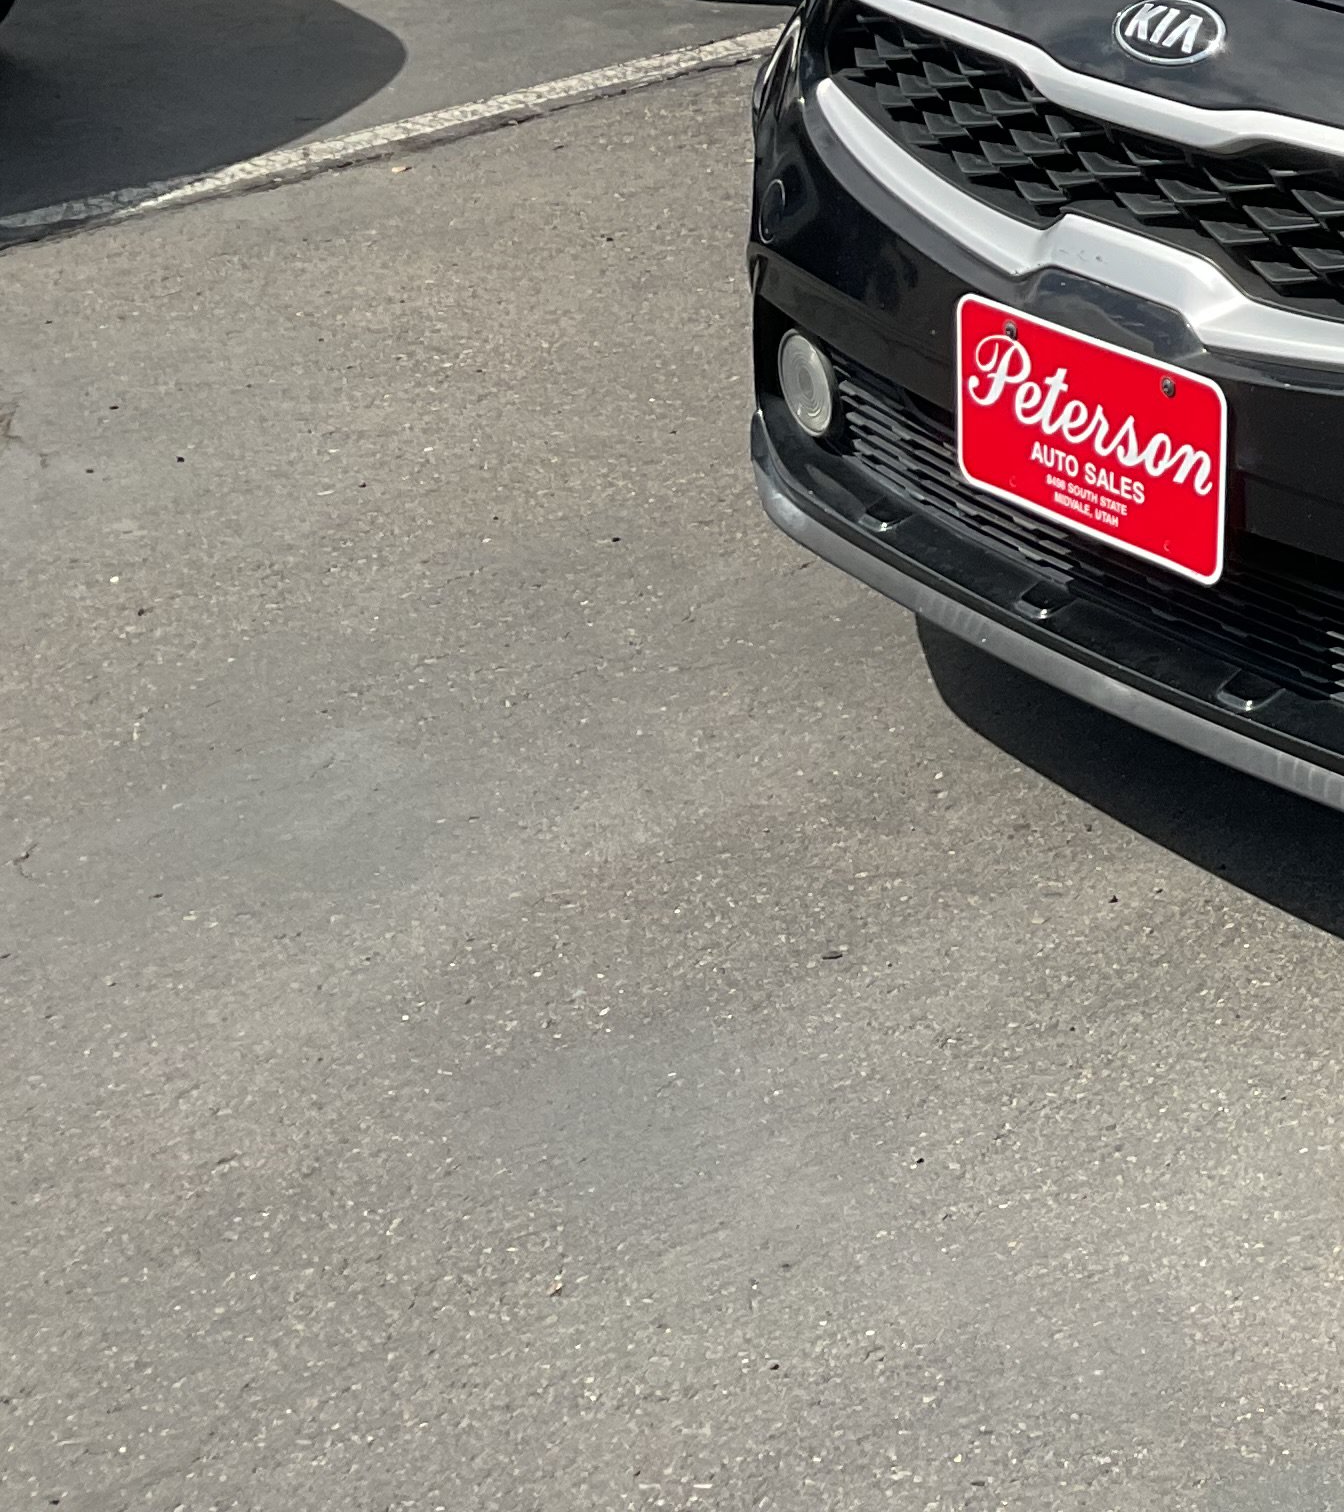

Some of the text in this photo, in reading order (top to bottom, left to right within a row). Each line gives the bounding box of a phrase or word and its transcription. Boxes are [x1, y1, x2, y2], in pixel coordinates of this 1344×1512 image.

[1124, 3, 1203, 54] KIA
[968, 334, 1213, 496] Peterson
[1030, 441, 1146, 505] AUTO SALES
[1067, 482, 1099, 505] SOUTH
[1099, 495, 1128, 516] STATE
[1094, 507, 1119, 528] UTAH
